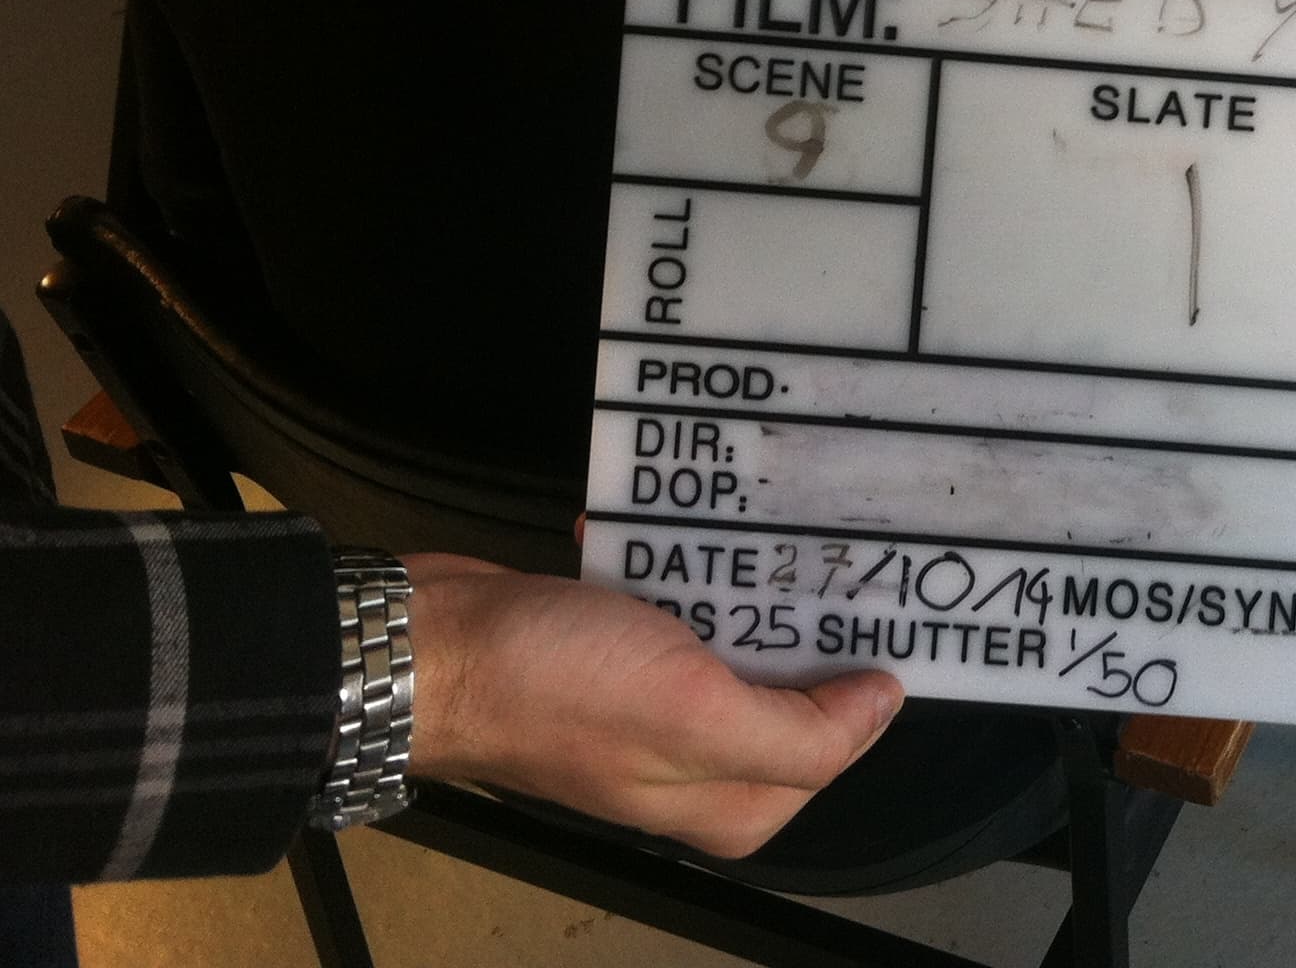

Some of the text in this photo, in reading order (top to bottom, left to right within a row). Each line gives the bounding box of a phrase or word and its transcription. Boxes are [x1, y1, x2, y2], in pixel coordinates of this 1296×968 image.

[693, 52, 867, 102] SCENE
[1090, 84, 1258, 133] SLATE
[645, 198, 692, 325] ROLL
[624, 540, 760, 589] DATE
[815, 613, 1047, 669] SHUTTER
